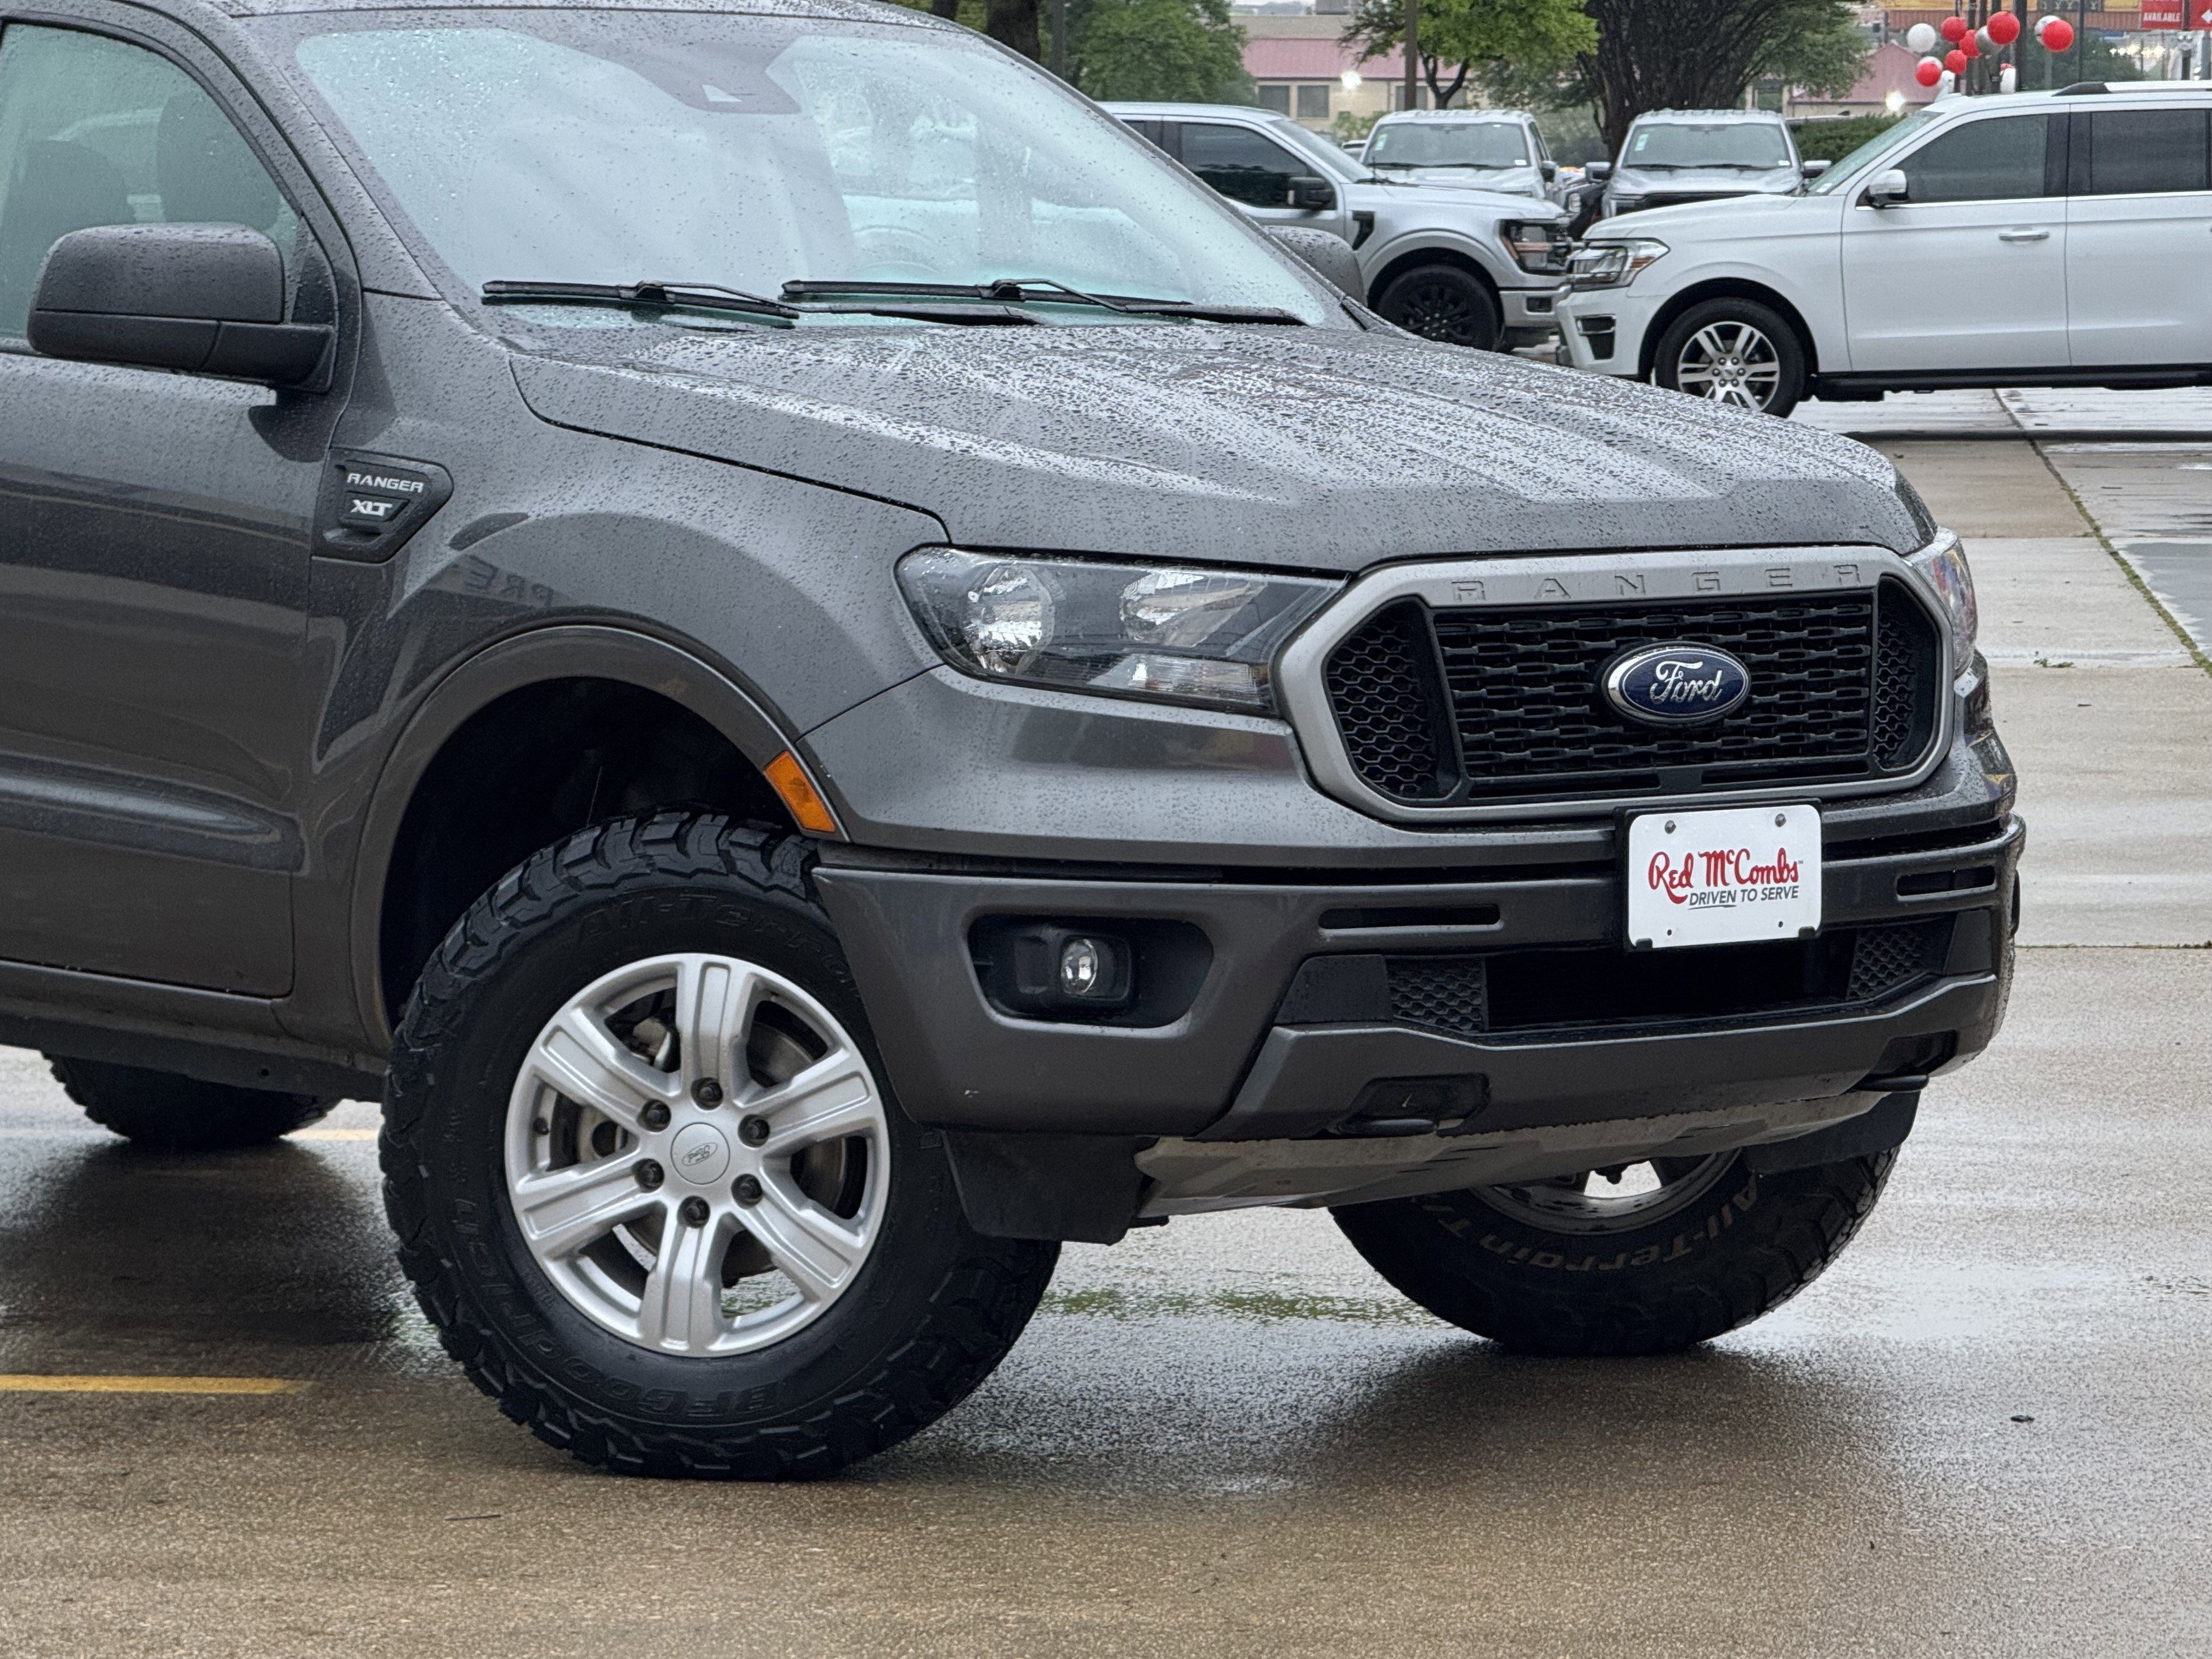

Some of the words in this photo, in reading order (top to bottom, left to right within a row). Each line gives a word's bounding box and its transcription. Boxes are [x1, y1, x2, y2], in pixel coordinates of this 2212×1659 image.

[2142, 12, 2181, 21] AVAILABLE
[346, 473, 424, 493] RANGER
[351, 499, 393, 517] XLT
[1450, 564, 1861, 601] RANGER
[1649, 660, 1724, 705] Ford
[1648, 851, 1694, 905] Red
[1698, 847, 1799, 887] McCombs
[1689, 890, 1738, 906] DRIVEN
[1741, 888, 1758, 902] TO
[1760, 885, 1800, 901] SERVE
[687, 1144, 711, 1164] Ford
[1478, 1172, 1757, 1272] All-Terrain
